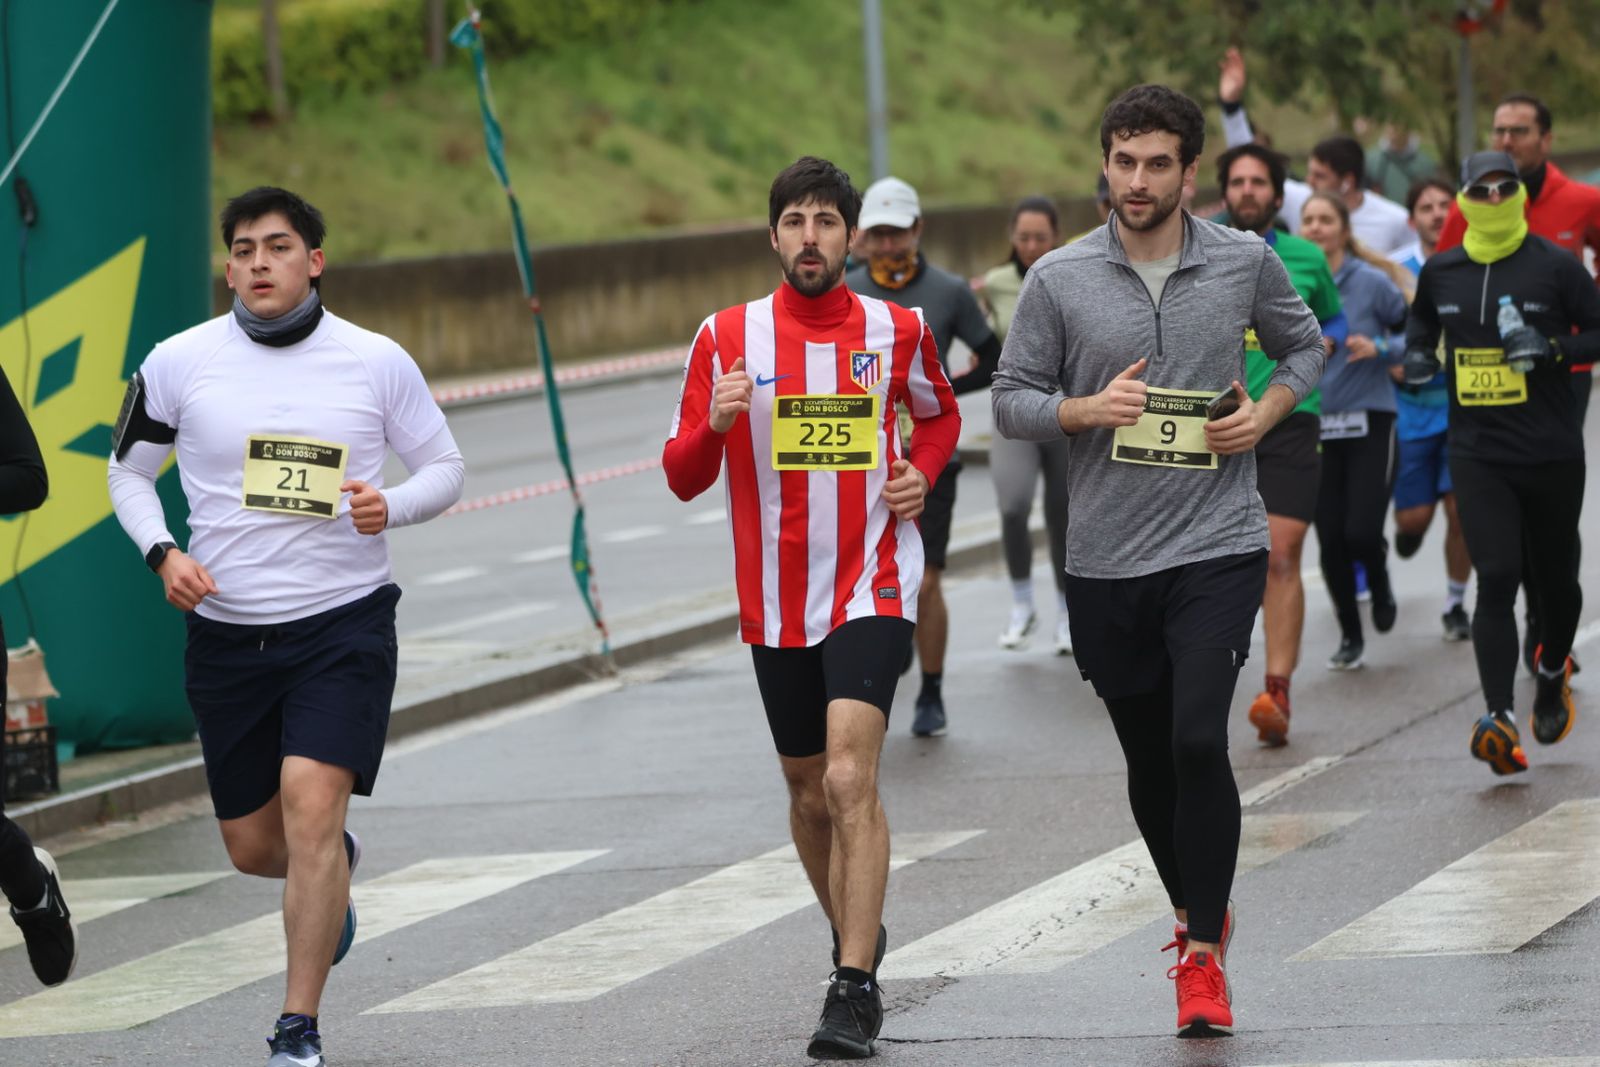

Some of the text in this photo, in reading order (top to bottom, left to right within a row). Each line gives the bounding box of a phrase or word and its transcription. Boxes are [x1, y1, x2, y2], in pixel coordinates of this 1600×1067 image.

[1470, 371, 1505, 389] 201
[1150, 401, 1167, 410] DON
[1168, 403, 1194, 411] BOSCO
[799, 422, 851, 446] 225
[1160, 420, 1177, 444] 9
[275, 448, 292, 456] DON
[294, 449, 318, 459] BOSCO
[277, 467, 310, 492] 21
